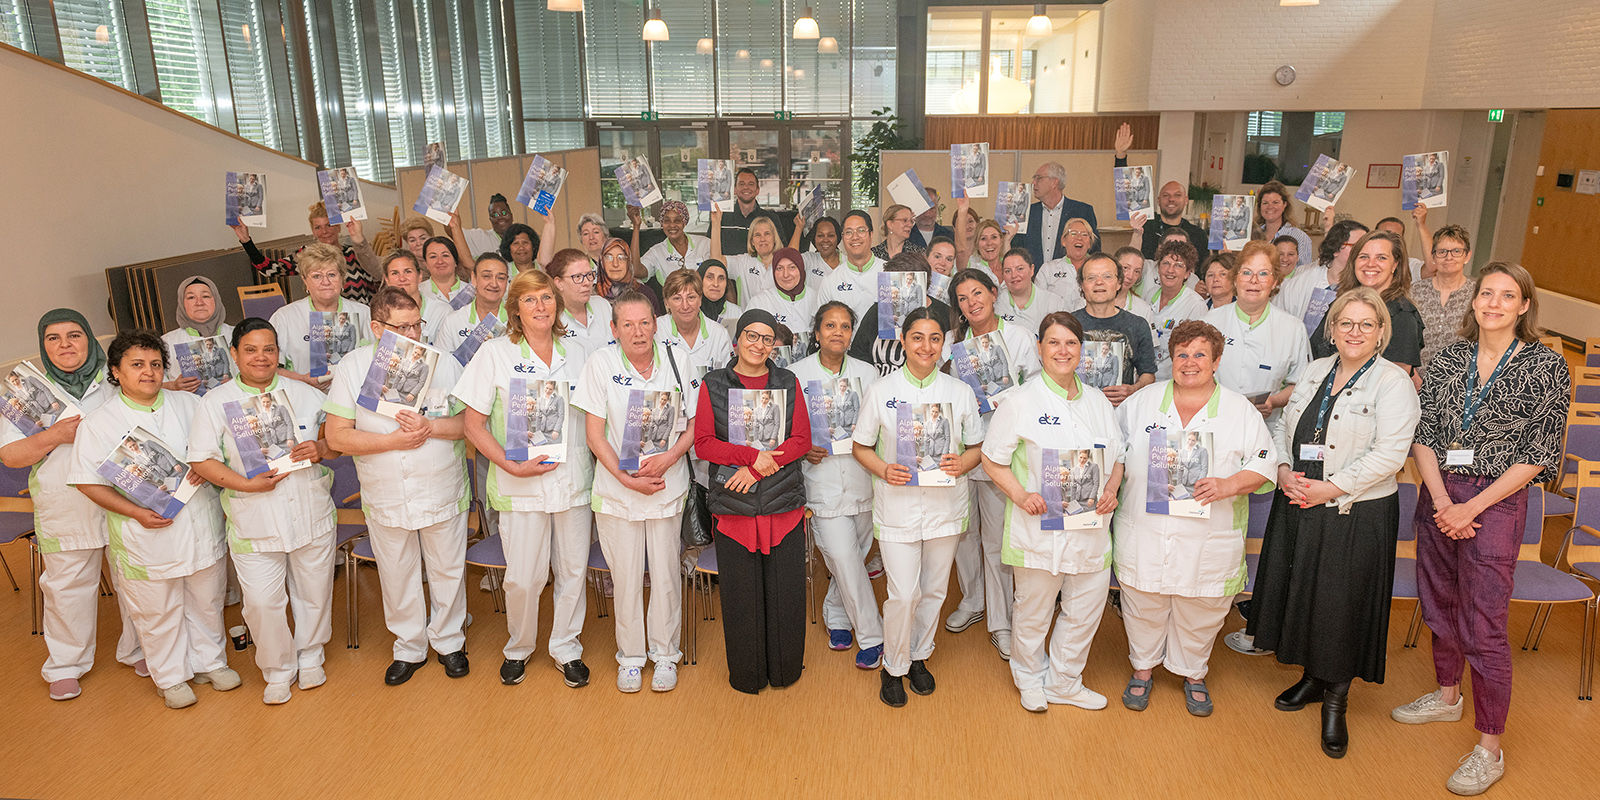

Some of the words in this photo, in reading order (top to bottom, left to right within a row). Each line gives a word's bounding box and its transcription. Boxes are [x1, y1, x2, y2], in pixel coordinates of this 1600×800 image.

[838, 282, 852, 291] etz
[459, 328, 471, 337] et
[514, 363, 536, 373] etz
[612, 374, 632, 386] etz
[886, 397, 906, 408] et
[1038, 413, 1060, 424] etz
